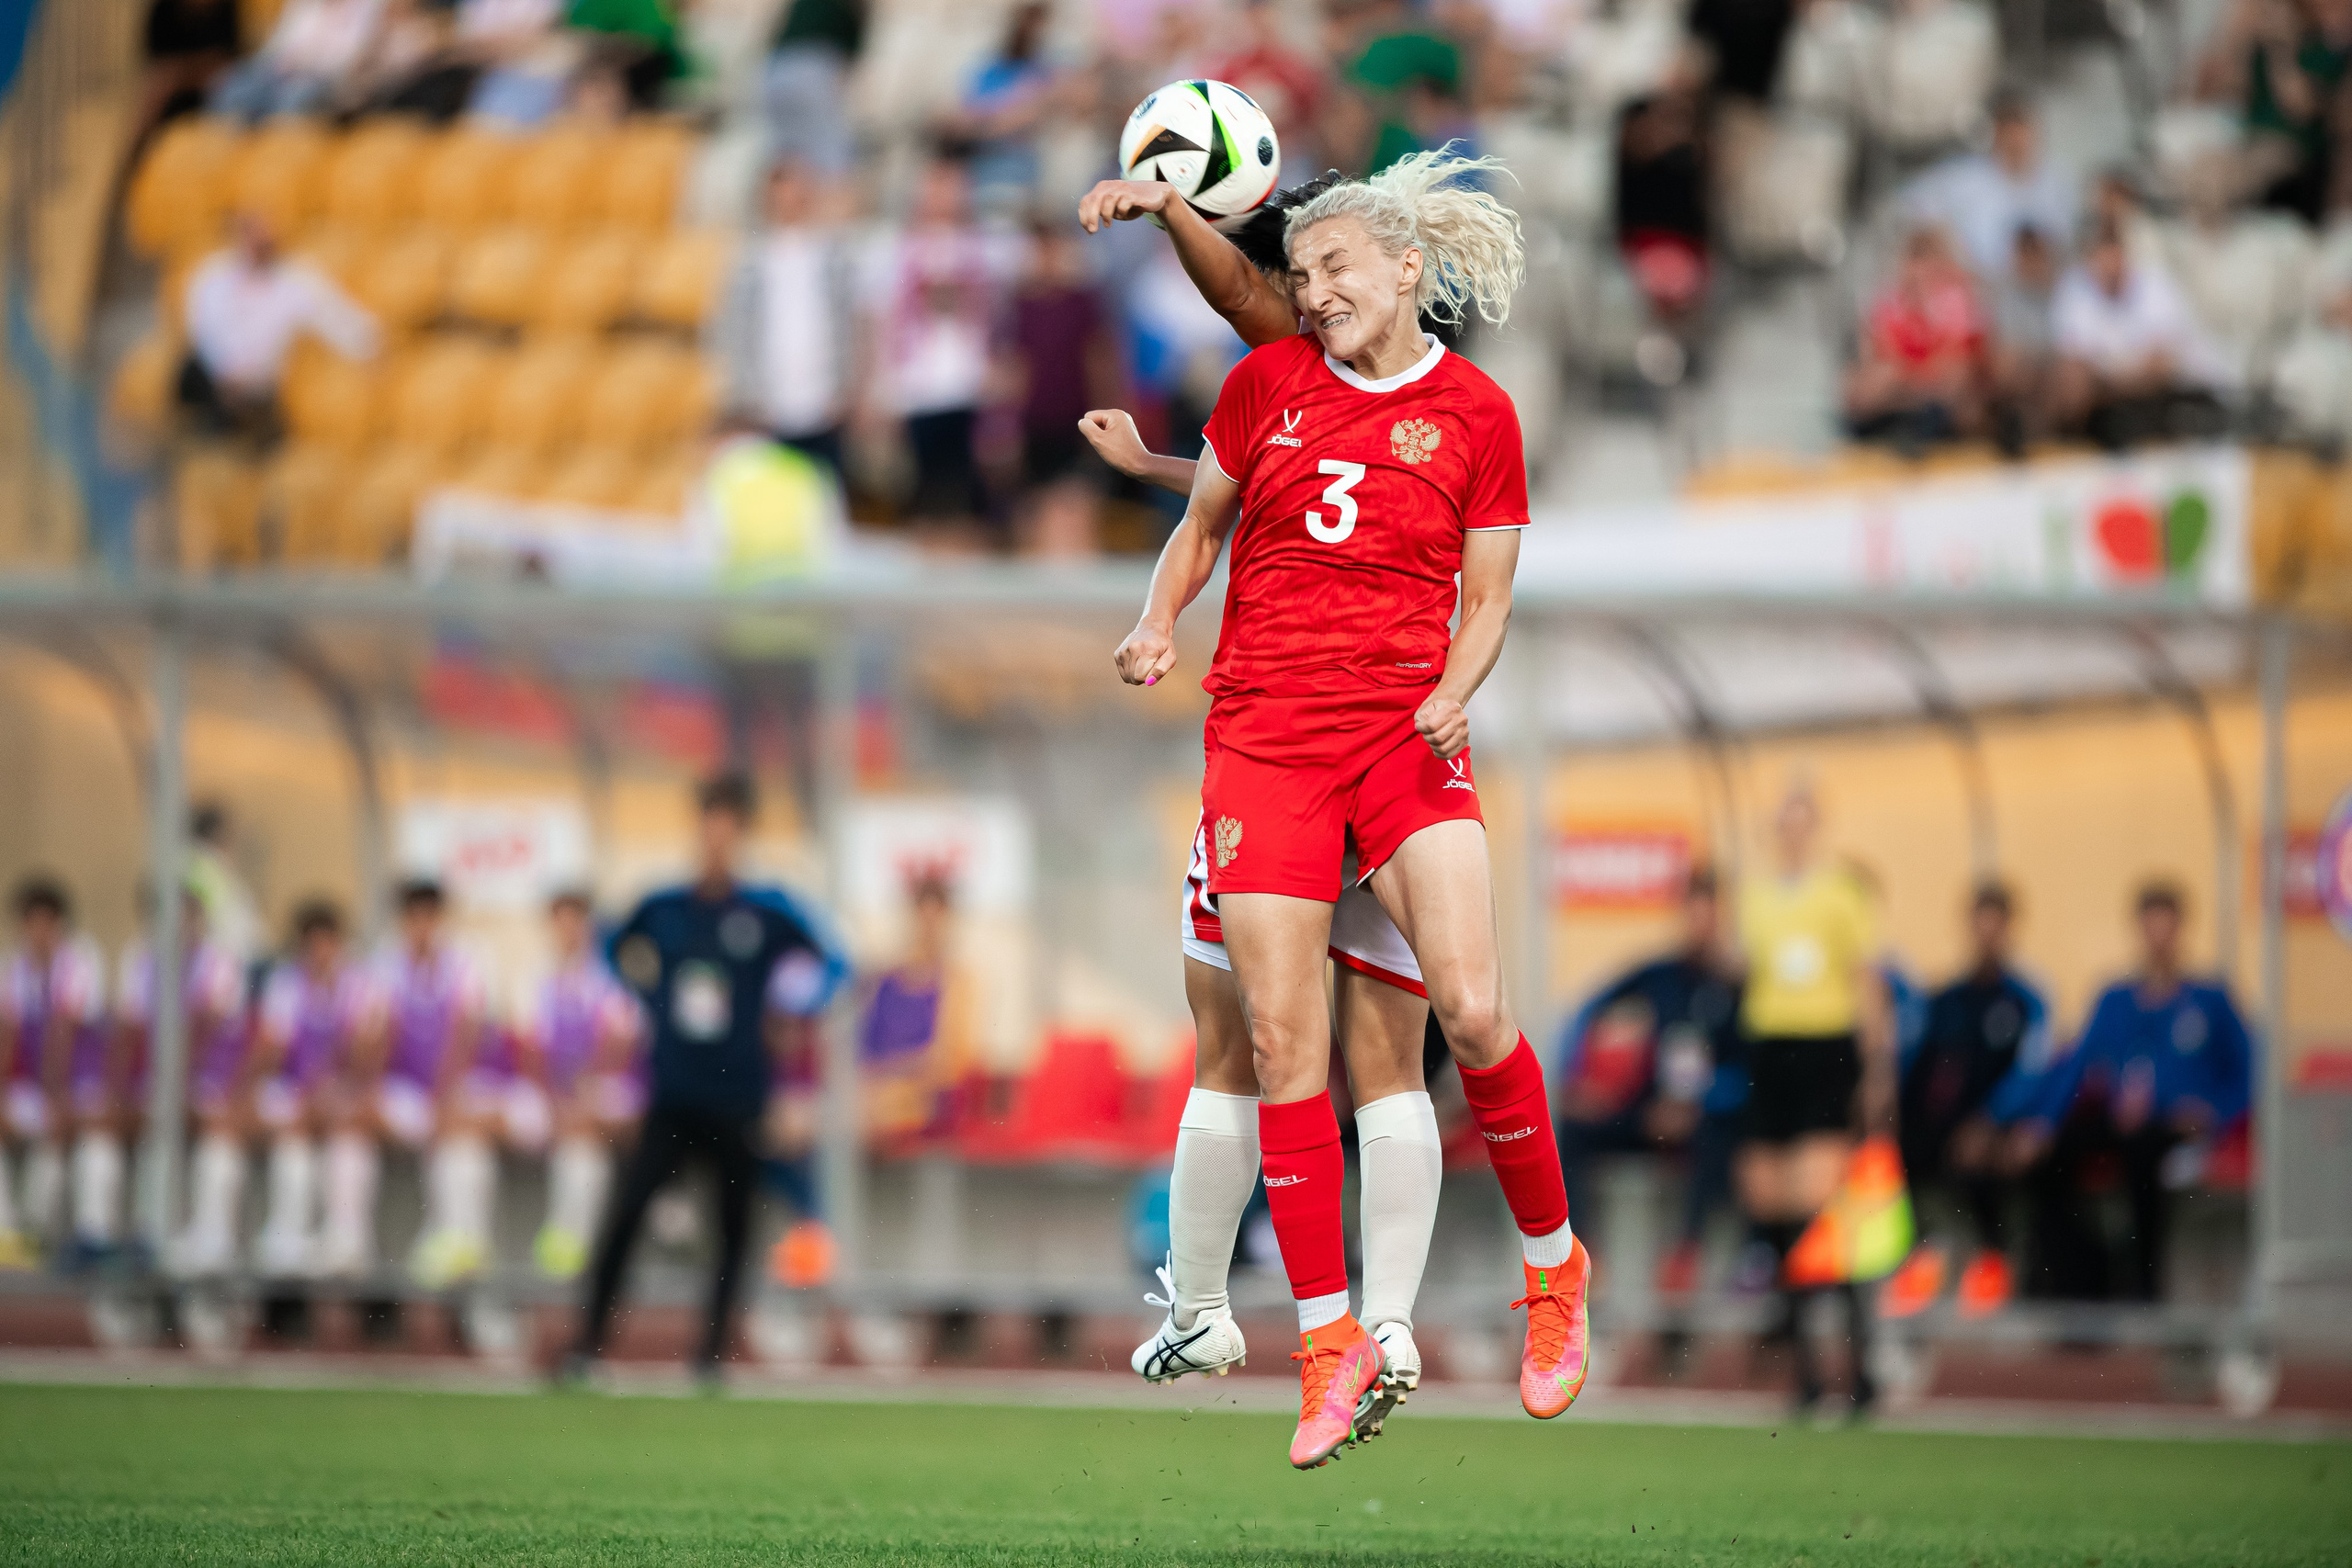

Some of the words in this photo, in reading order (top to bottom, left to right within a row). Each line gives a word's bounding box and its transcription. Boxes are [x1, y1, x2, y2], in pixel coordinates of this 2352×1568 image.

[1267, 434, 1302, 447] JÖGEL
[1306, 459, 1366, 544] 3
[1442, 778, 1476, 793] JÖGEL
[1263, 1175, 1308, 1187] ÖGEL
